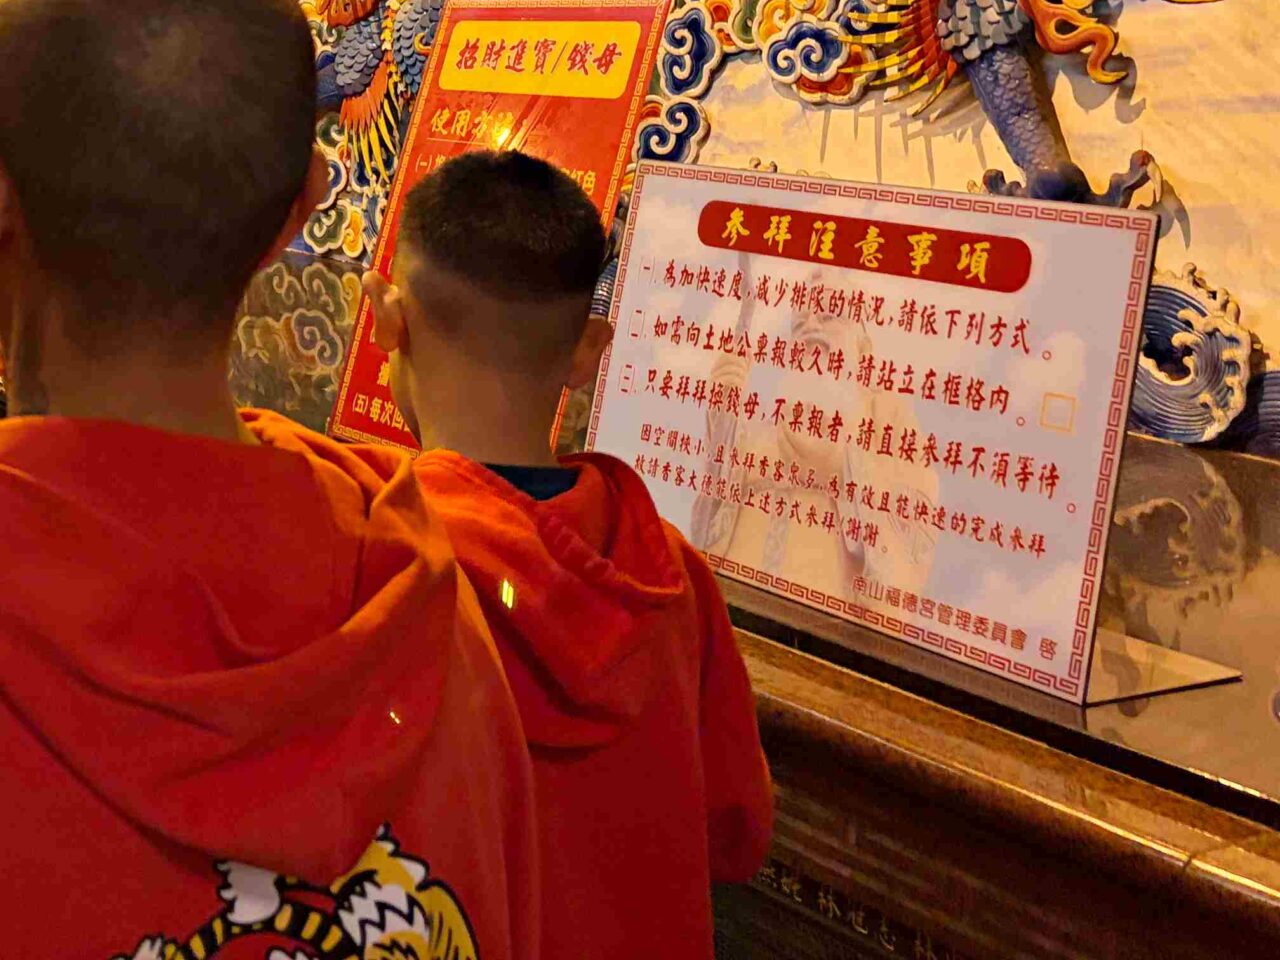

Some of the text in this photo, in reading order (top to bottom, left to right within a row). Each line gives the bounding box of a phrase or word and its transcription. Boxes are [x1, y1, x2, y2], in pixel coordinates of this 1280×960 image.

[721, 206, 991, 284] 參拜注意事項
[352, 392, 411, 432] (五)每次回
[851, 575, 1029, 651] 南山福德宮管理委員會
